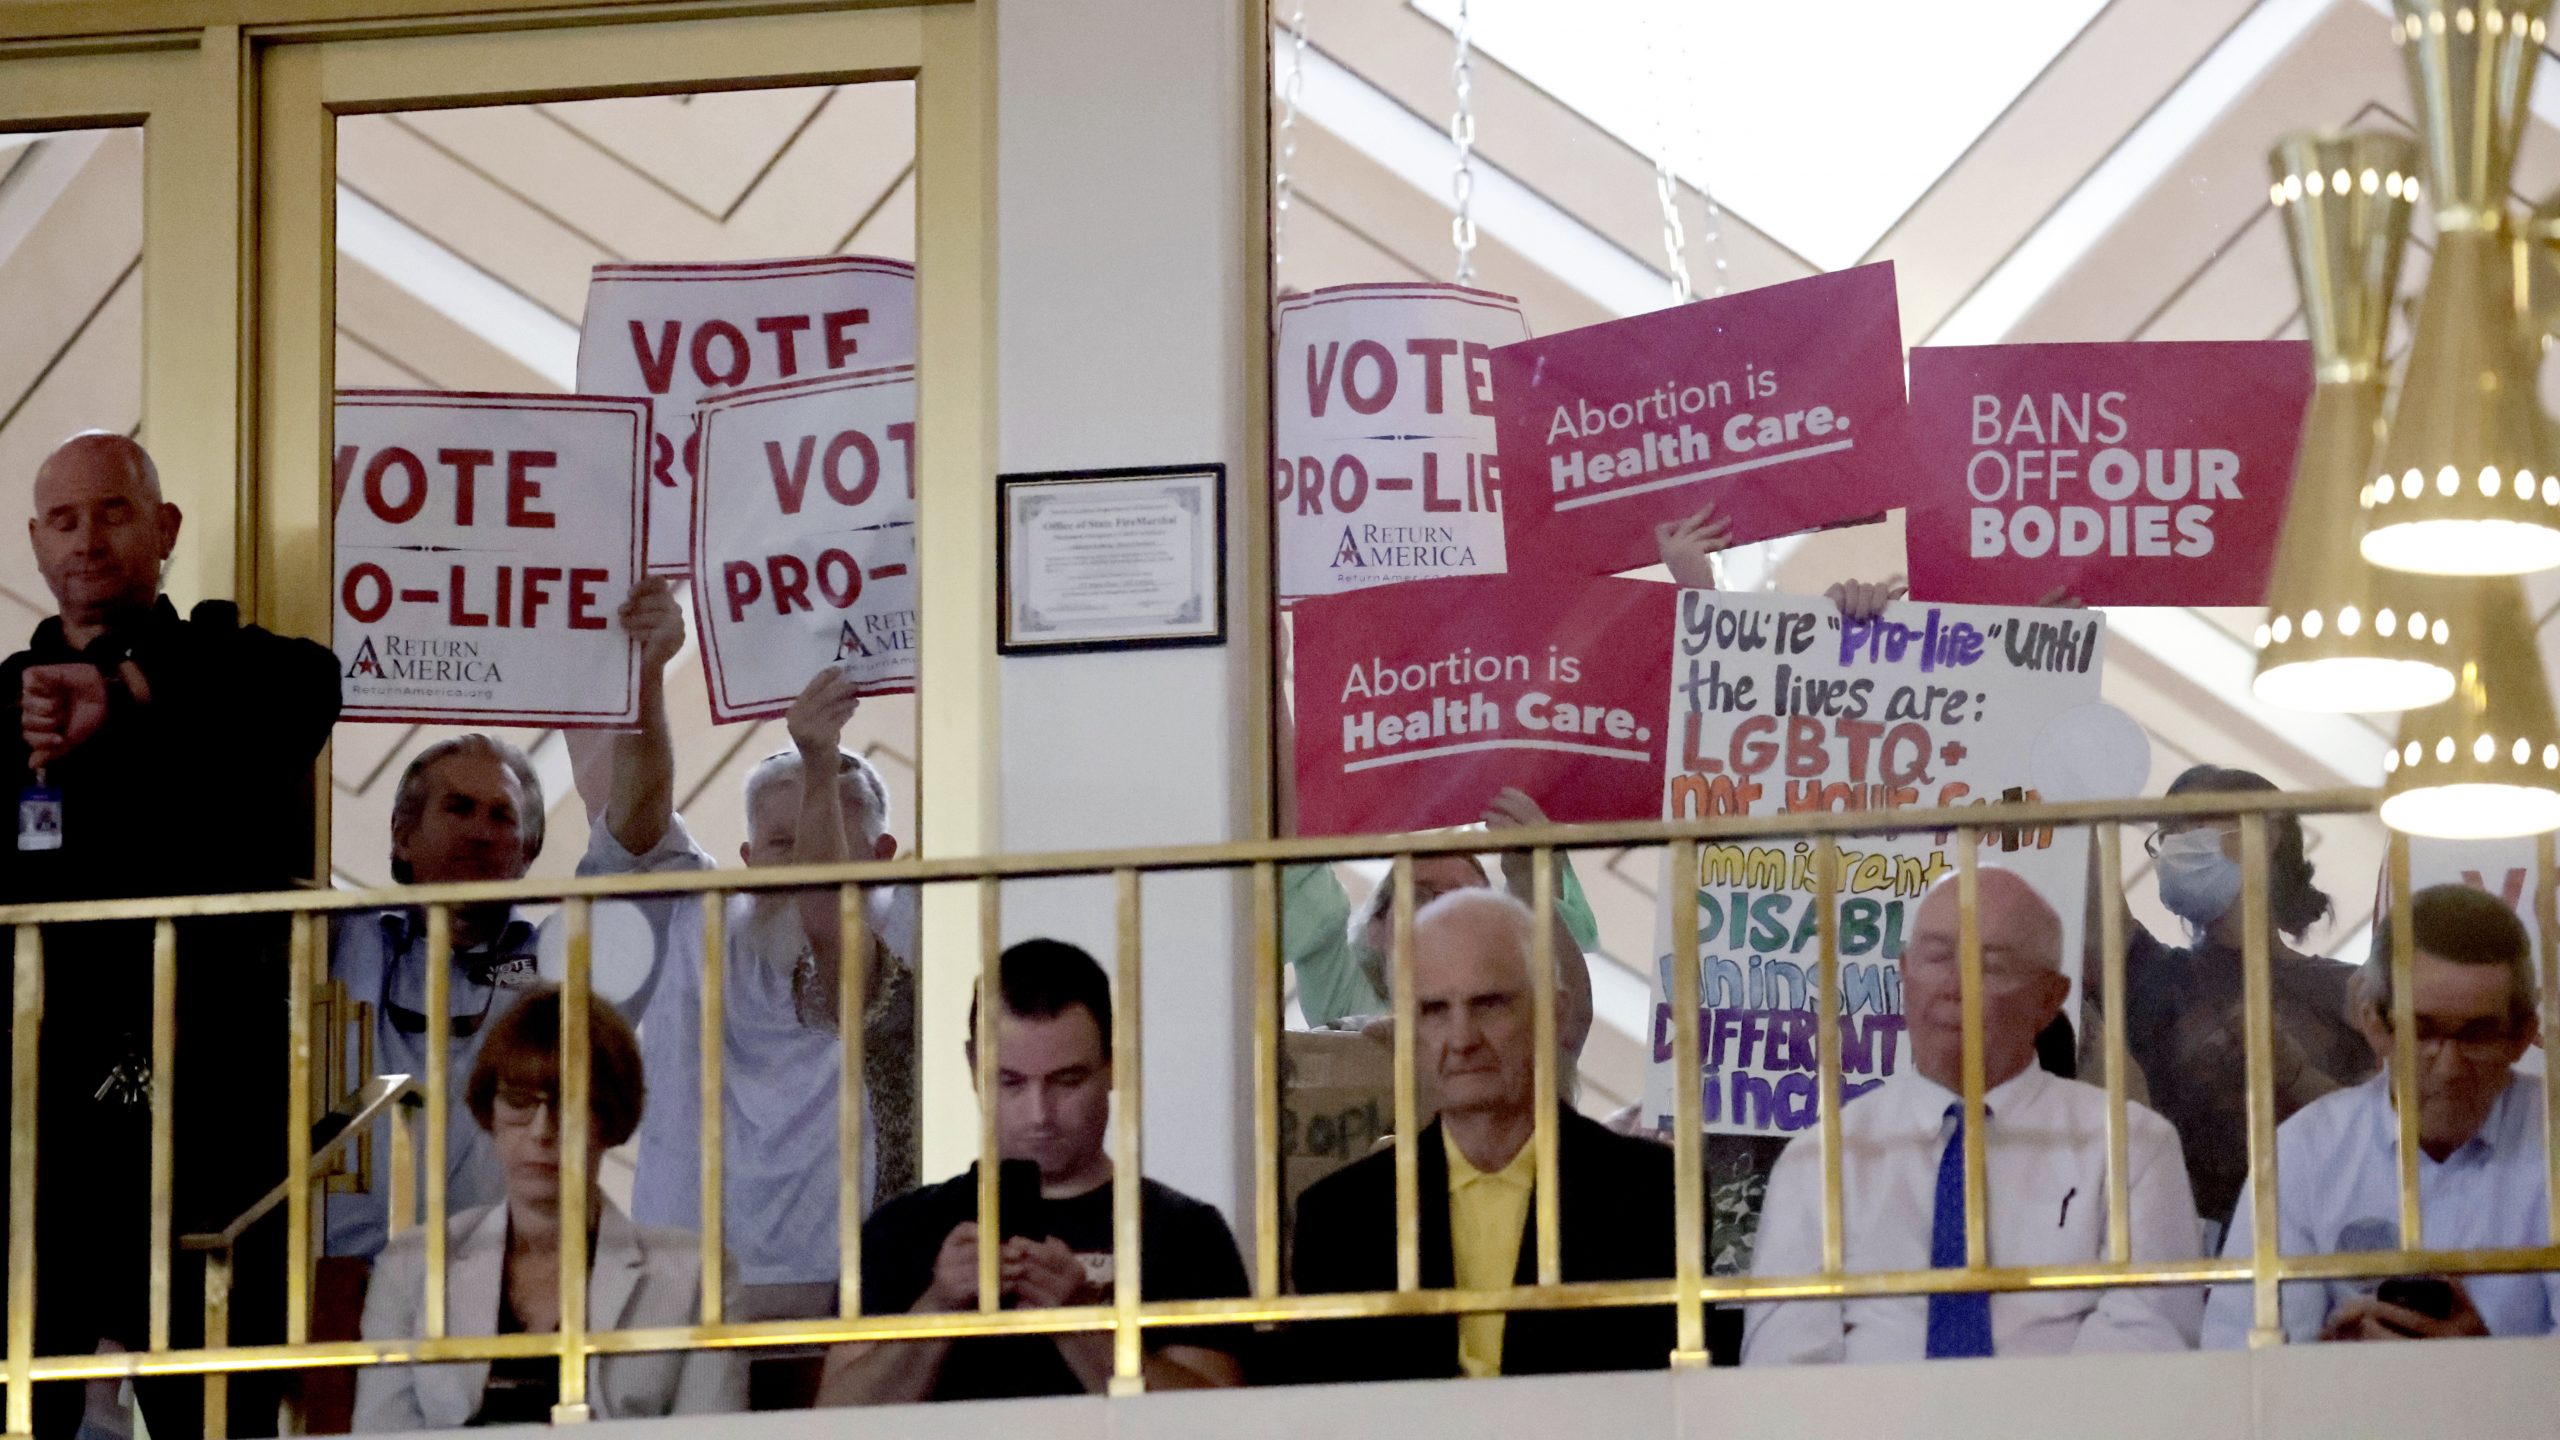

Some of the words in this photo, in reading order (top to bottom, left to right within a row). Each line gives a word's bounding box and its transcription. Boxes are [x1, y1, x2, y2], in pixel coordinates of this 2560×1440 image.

[1306, 339, 1494, 417] VOTE
[1546, 374, 1732, 446] Abortion
[1746, 363, 1778, 401] is
[1972, 391, 2128, 445] BANS
[765, 423, 916, 515] VOT
[1550, 427, 1712, 493] Health
[1722, 402, 1850, 455] Care.
[1967, 449, 2079, 502] OFF
[2088, 448, 2243, 501] OUR
[1277, 452, 1503, 517] PRO-LIF
[1330, 525, 1477, 568] AMERICA
[1364, 523, 1454, 544] RETURN
[1970, 505, 2215, 558] BODIES
[344, 634, 502, 682] AMERICA
[386, 635, 478, 658] RETURN
[1341, 647, 1529, 703] Abortion
[1548, 646, 1581, 684] is
[353, 685, 493, 700] ReturnAmerica.org
[1679, 660, 1757, 713] the
[1774, 664, 1875, 721] lives
[1886, 683, 1987, 725] are:
[1342, 692, 1500, 753] Health
[1515, 692, 1650, 742] Care.
[1683, 712, 1967, 787] LGBTQ+
